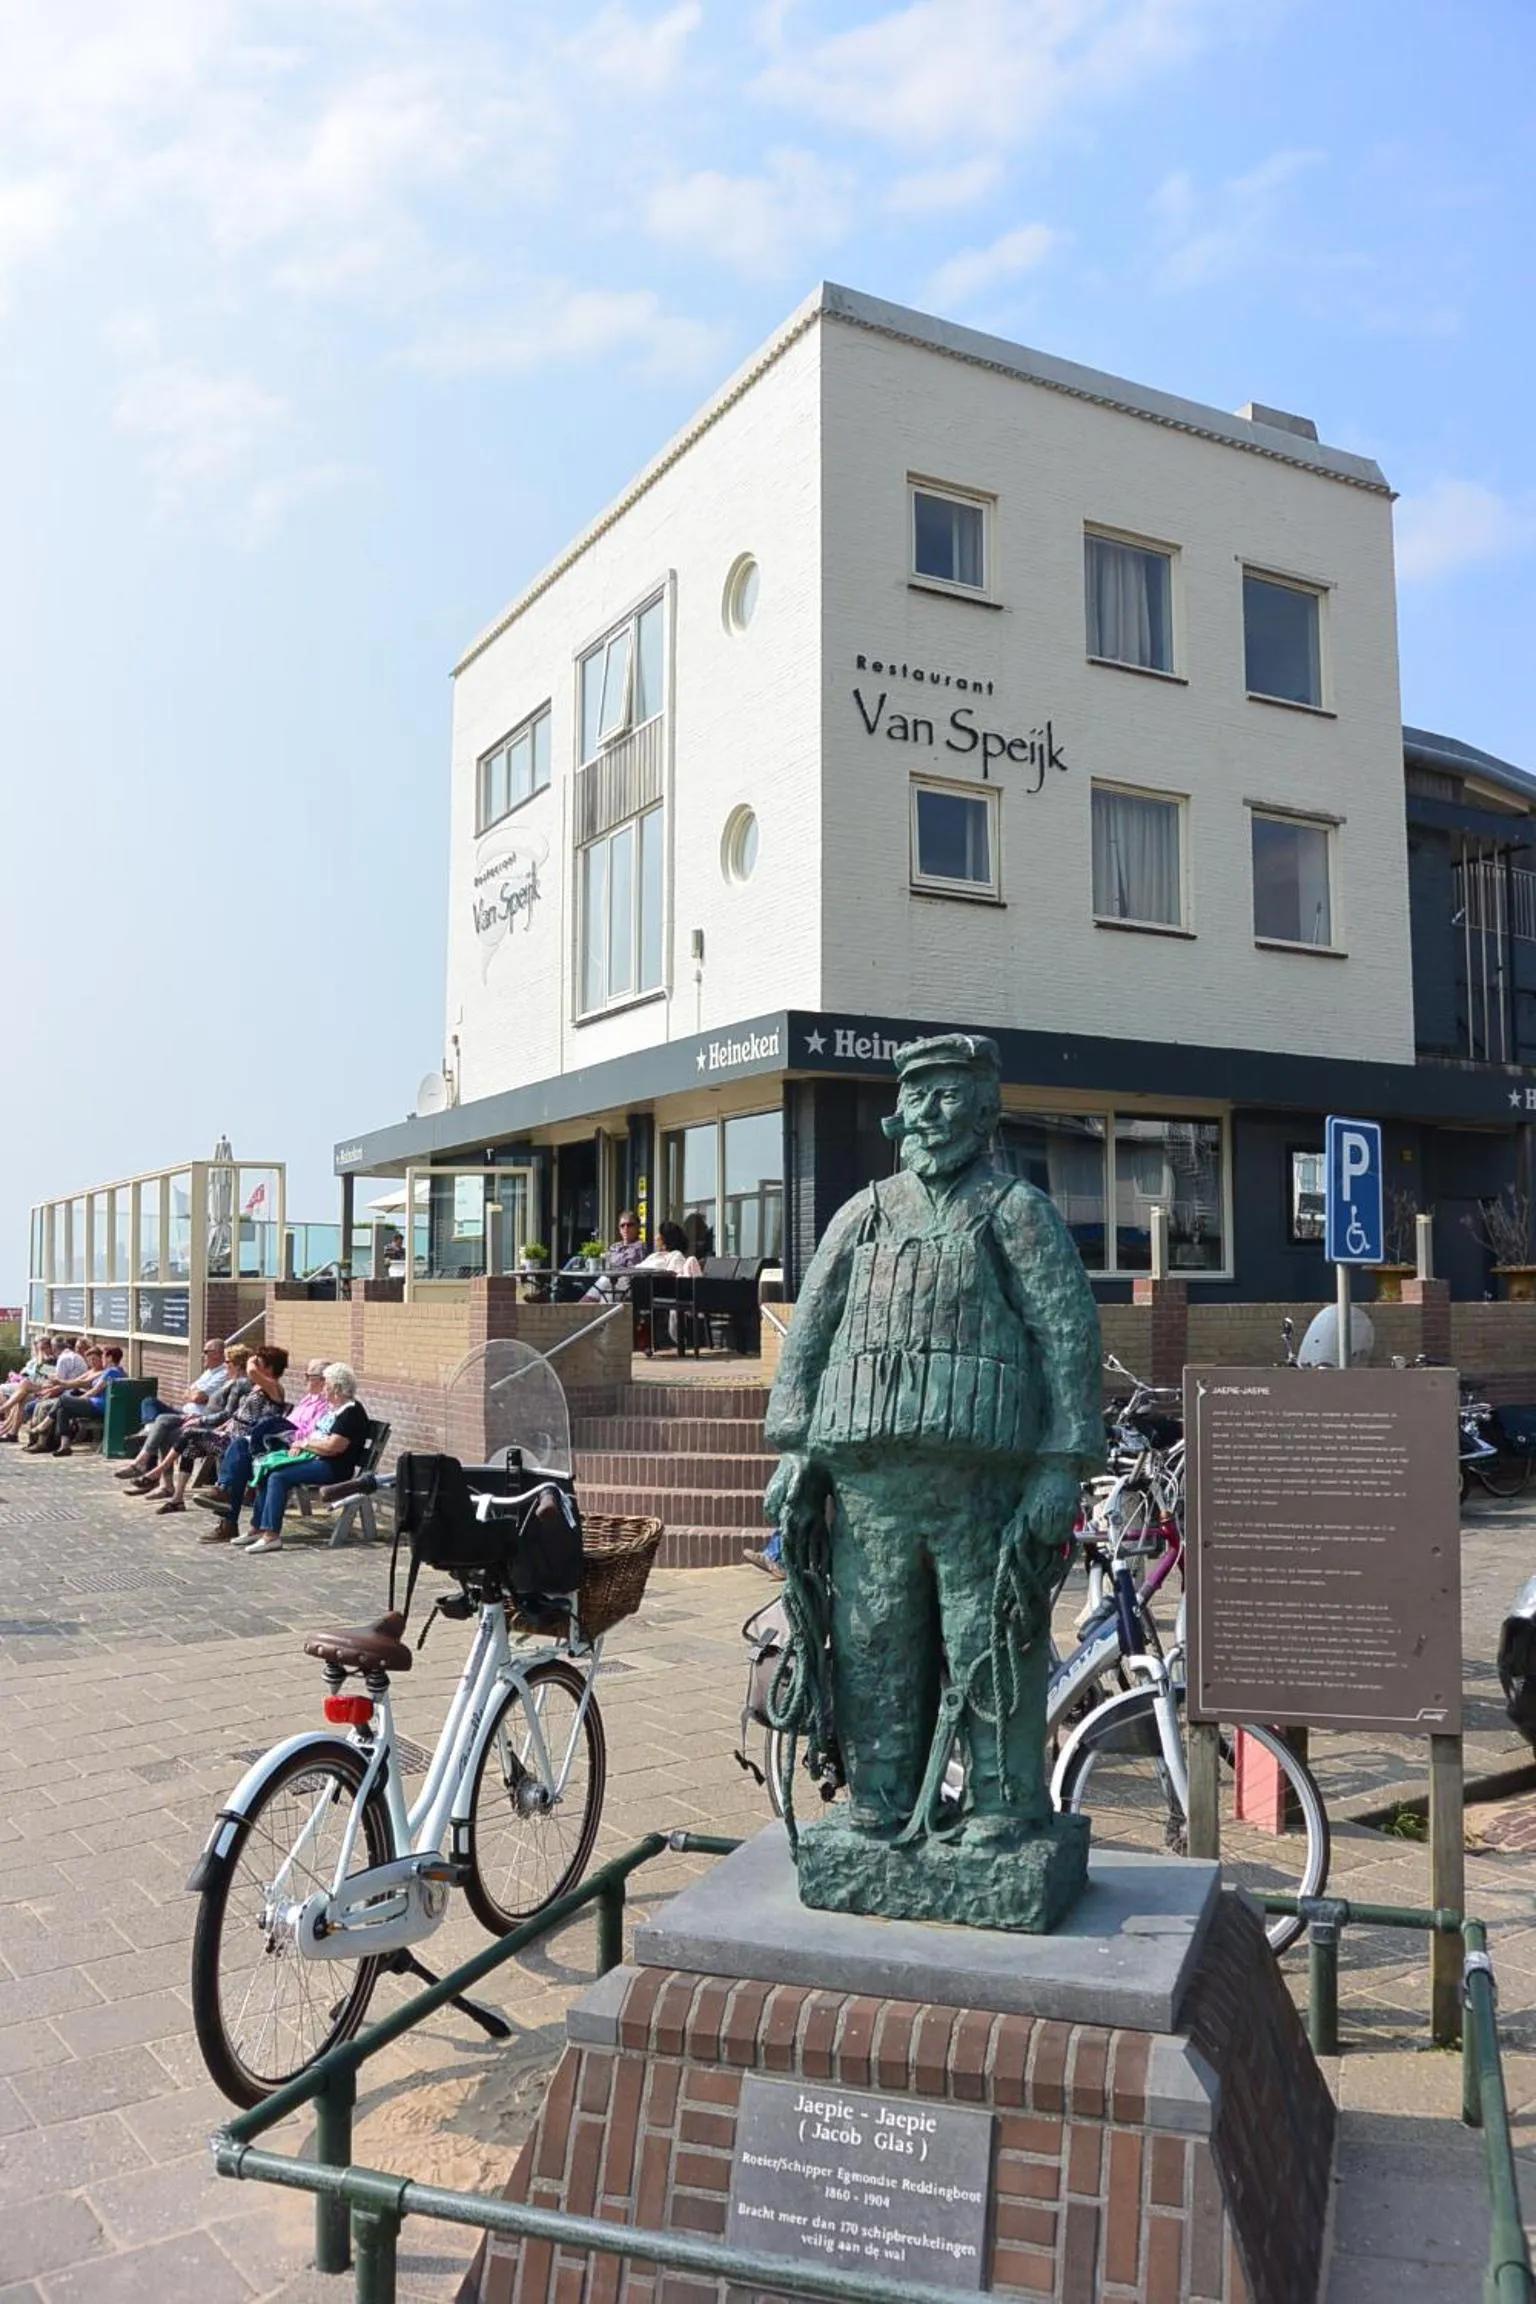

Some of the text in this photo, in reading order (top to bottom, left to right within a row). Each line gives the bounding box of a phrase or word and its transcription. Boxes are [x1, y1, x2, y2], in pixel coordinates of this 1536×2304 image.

[856, 654, 995, 695] Restaurant
[852, 687, 1068, 794] Van Speijk
[708, 1028, 780, 1070] Heineken
[834, 1029, 914, 1061] Hein
[1342, 1131, 1370, 1202] P
[793, 2094, 854, 2123] Jaepie
[874, 2107, 937, 2137] Jaepie
[824, 2186, 851, 2202] 1860
[863, 2191, 891, 2209] 1904
[837, 2166, 899, 2189] Egmondse
[738, 2202, 977, 2260] Bracht meer dan 170 schipbreukelingen
[800, 2231, 906, 2262] veilig aan de wal
